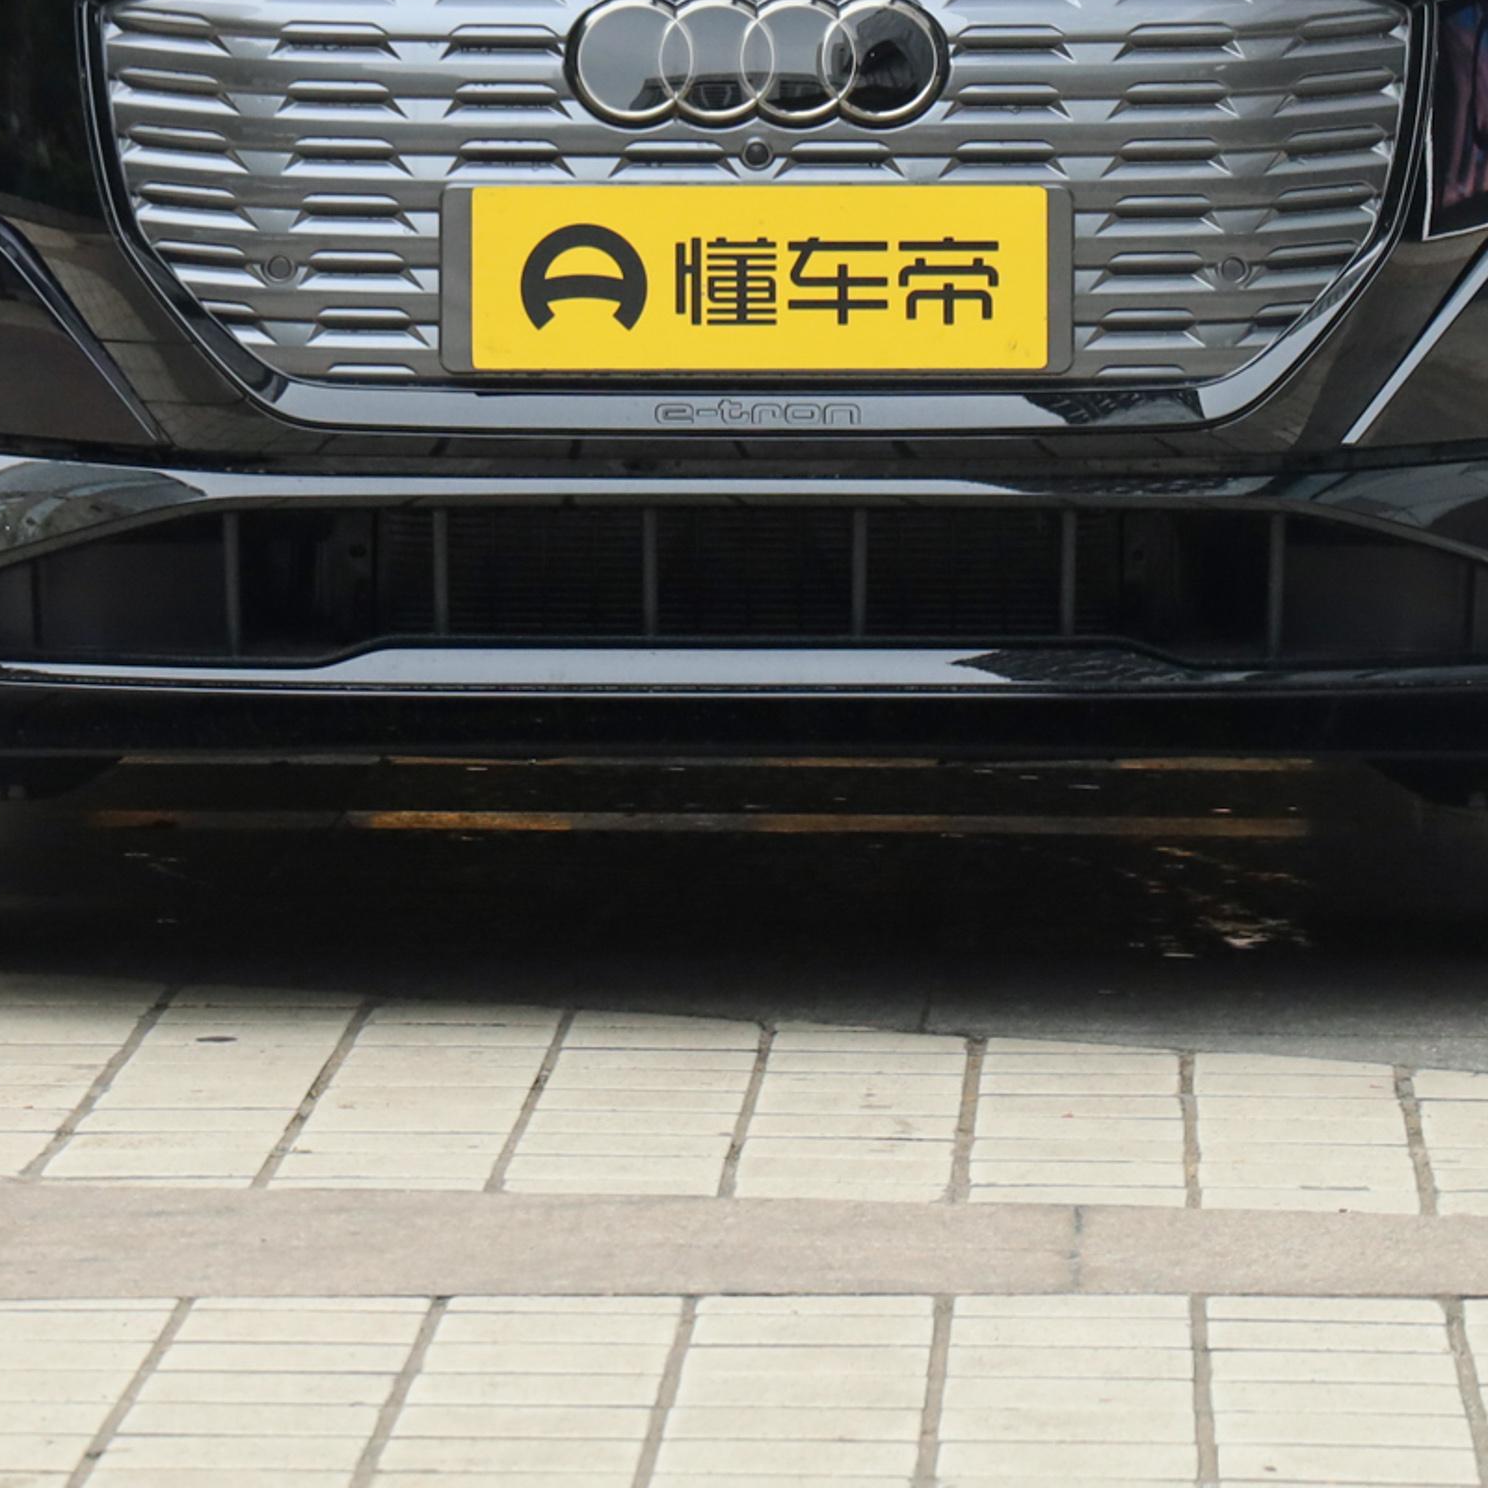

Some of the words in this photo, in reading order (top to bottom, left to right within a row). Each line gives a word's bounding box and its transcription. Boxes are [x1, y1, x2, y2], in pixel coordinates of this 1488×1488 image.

[675, 236, 999, 326] 懂车帝
[654, 398, 862, 426] e-tron
